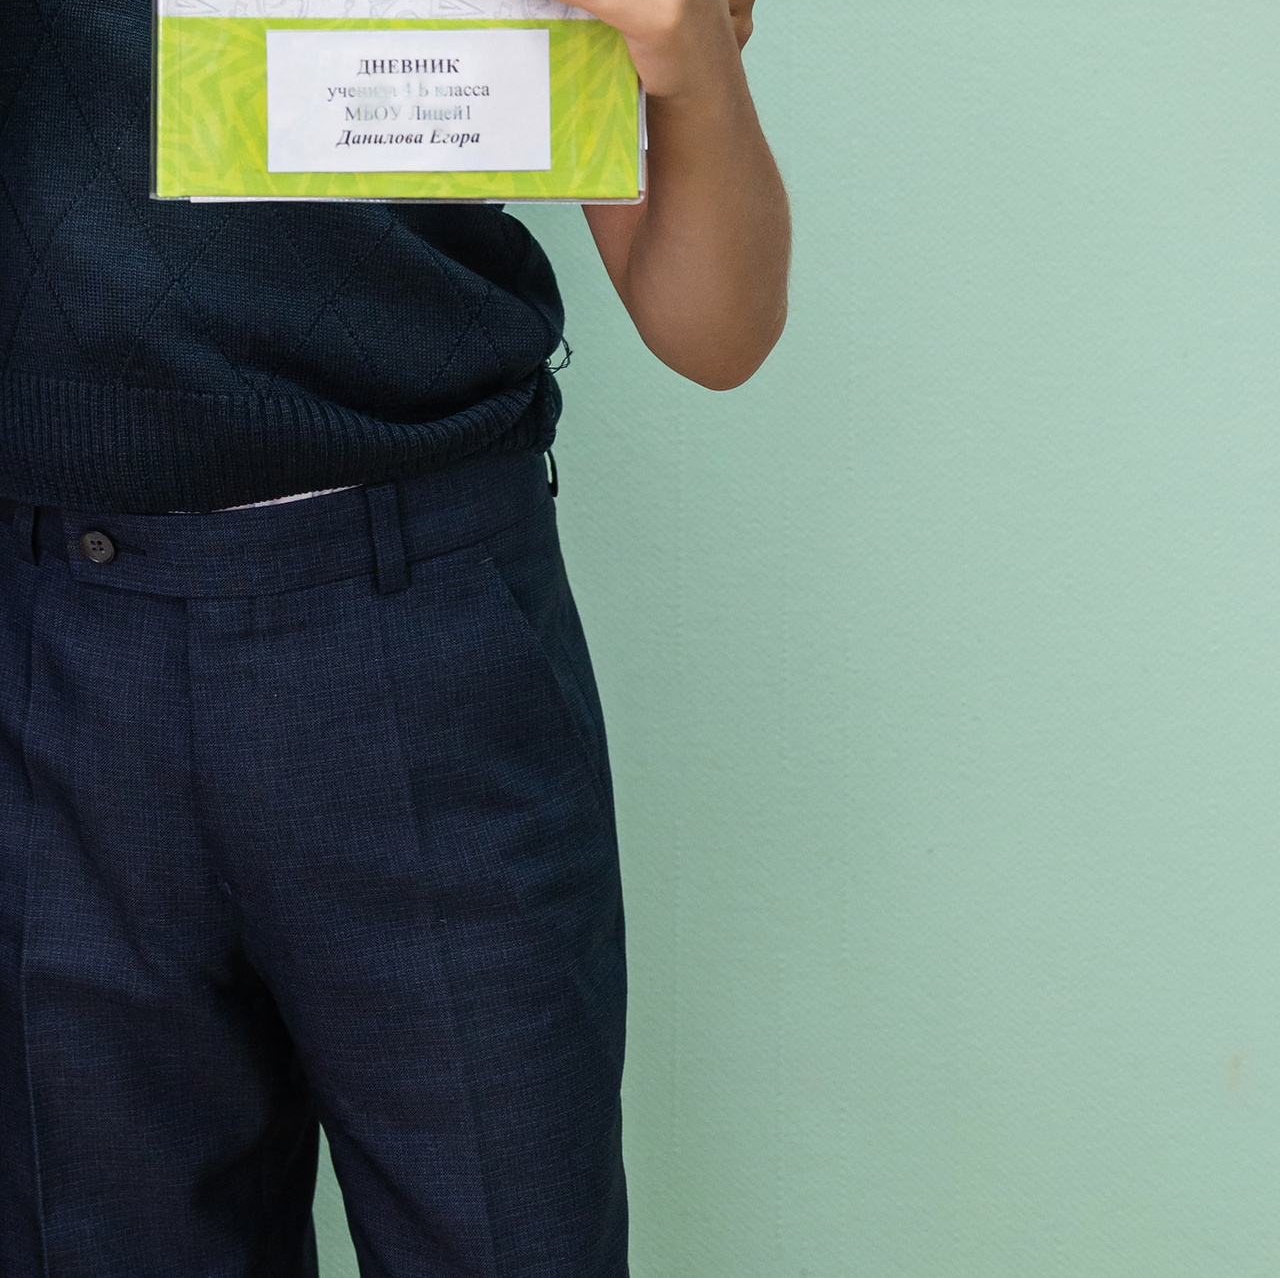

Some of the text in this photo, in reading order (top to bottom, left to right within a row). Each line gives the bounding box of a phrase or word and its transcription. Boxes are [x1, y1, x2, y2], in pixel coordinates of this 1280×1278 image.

[357, 58, 460, 76] ДНЕВНИК
[435, 84, 490, 98] класса
[336, 129, 481, 148] Данилова Егора
